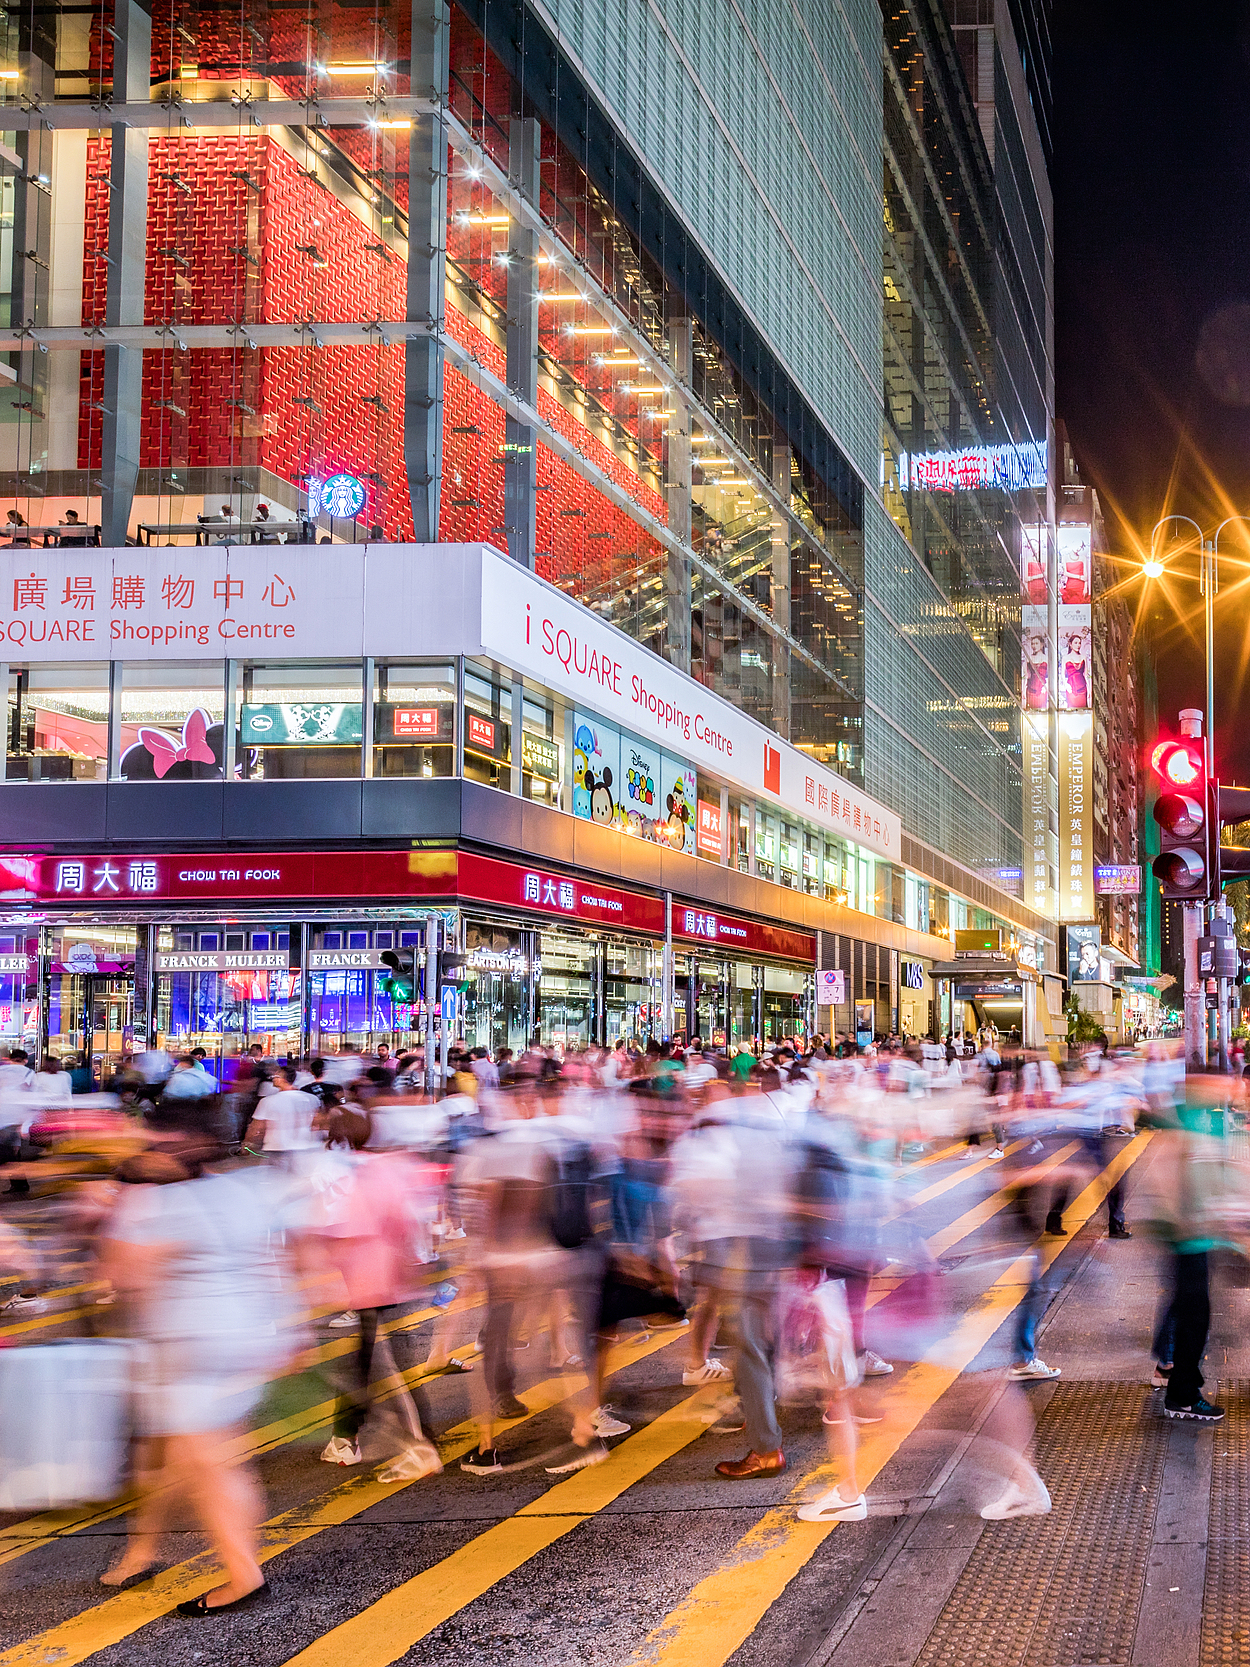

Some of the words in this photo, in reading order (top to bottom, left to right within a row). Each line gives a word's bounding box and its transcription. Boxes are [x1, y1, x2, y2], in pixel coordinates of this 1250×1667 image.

[13, 572, 297, 612] 廣場購物中心
[109, 620, 210, 645] Shopping
[217, 618, 296, 640] Centre
[525, 604, 532, 645] i
[542, 618, 623, 697] SQUARE
[631, 674, 691, 741] Shopping
[694, 713, 733, 758] Centre
[400, 712, 432, 724] 周大福
[630, 749, 650, 775] Disney
[1072, 743, 1084, 814] EMPEROR
[702, 808, 721, 833] 周大
[804, 775, 891, 847] 國際廣場購物中心
[56, 861, 158, 893] 周大福
[179, 870, 216, 882] CHOW
[219, 870, 241, 881] TAI
[245, 869, 281, 881] FOOK
[525, 873, 574, 910] 周大福
[581, 895, 598, 906] CHOW
[608, 901, 623, 911] FOOK
[685, 911, 716, 937] 周大福
[159, 955, 218, 968] FRANCK
[224, 954, 286, 968] MULLER
[312, 954, 371, 967] FRANCK
[905, 962, 924, 990] M&S
